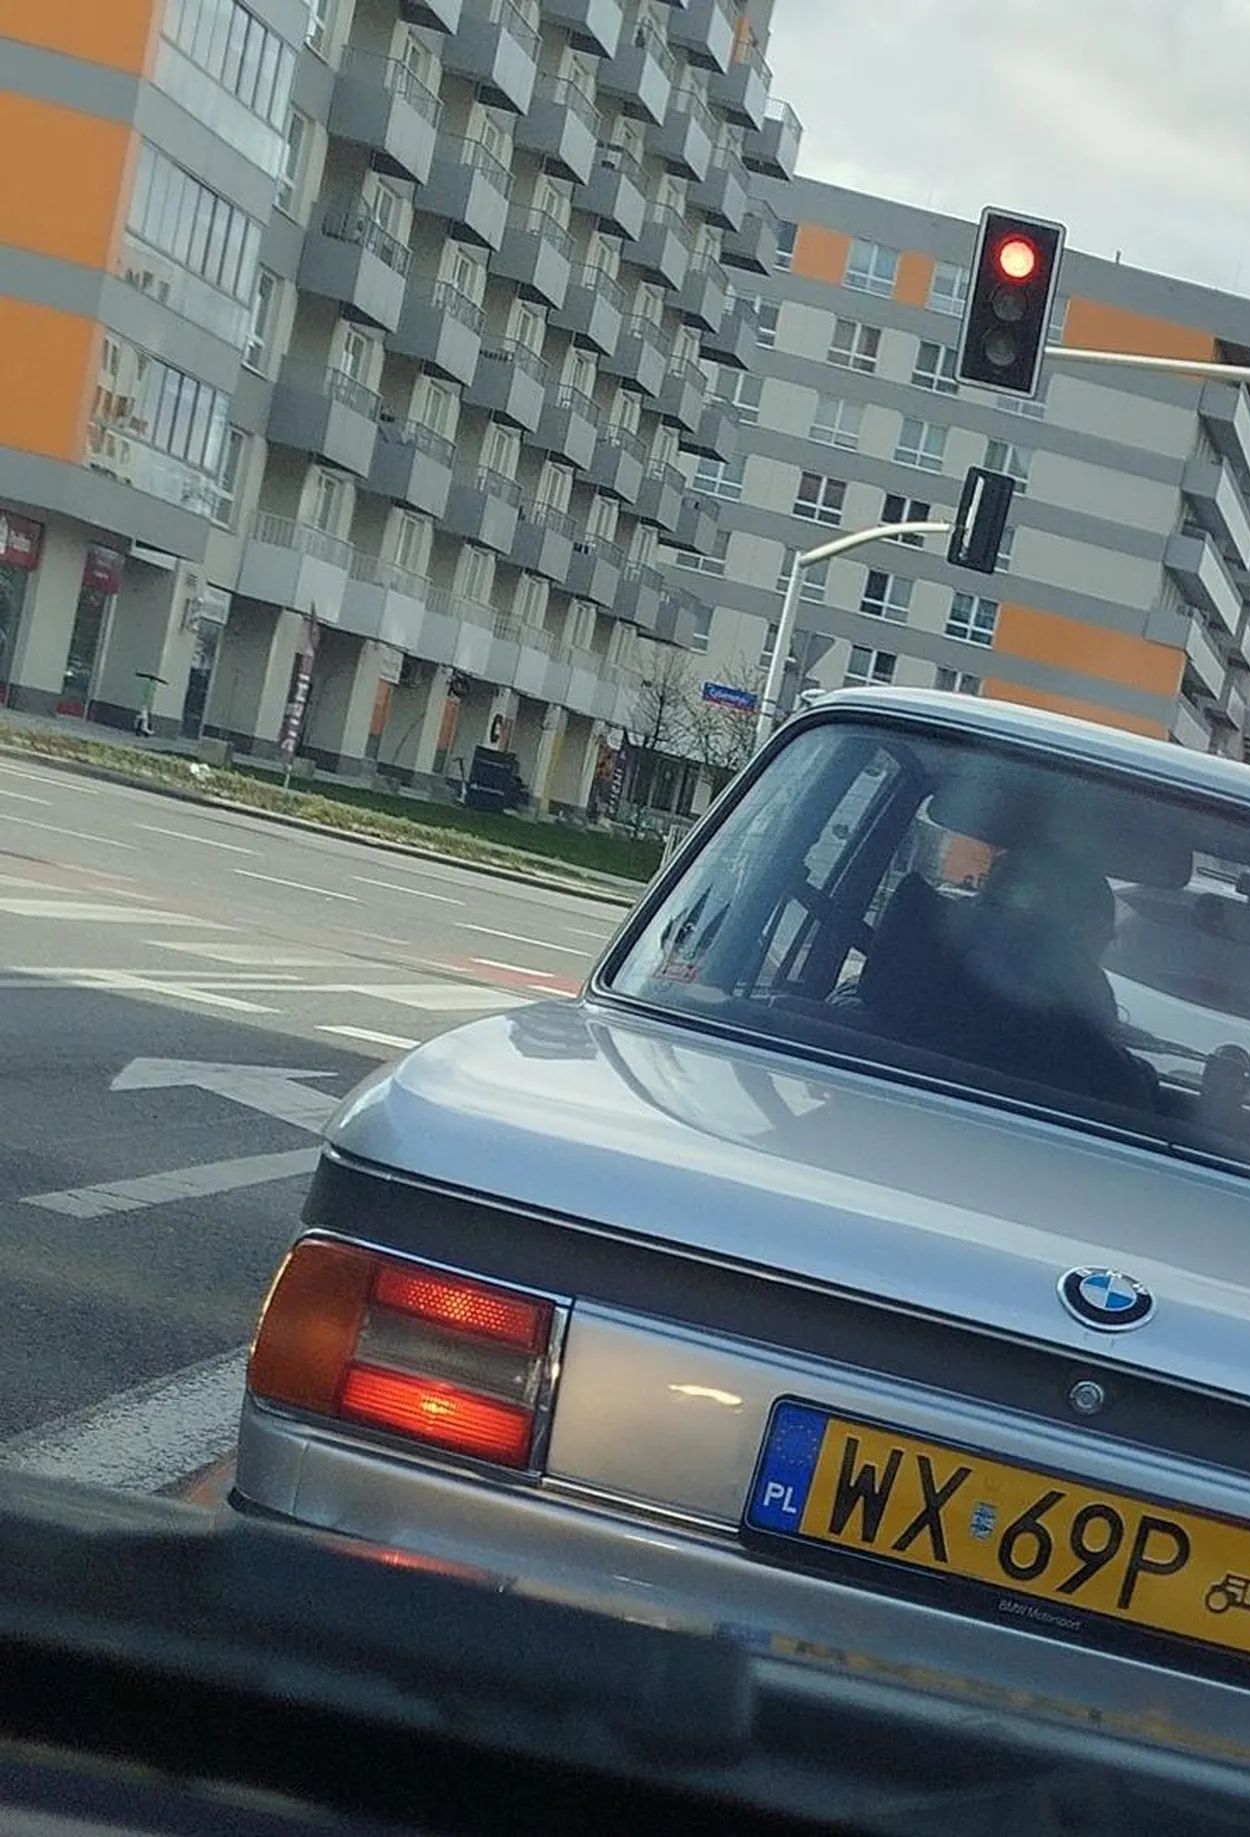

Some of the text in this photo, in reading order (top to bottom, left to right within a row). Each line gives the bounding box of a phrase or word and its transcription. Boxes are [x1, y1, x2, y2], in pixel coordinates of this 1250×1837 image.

[763, 1481, 797, 1513] PL
[829, 1437, 1190, 1610] WX 69P
